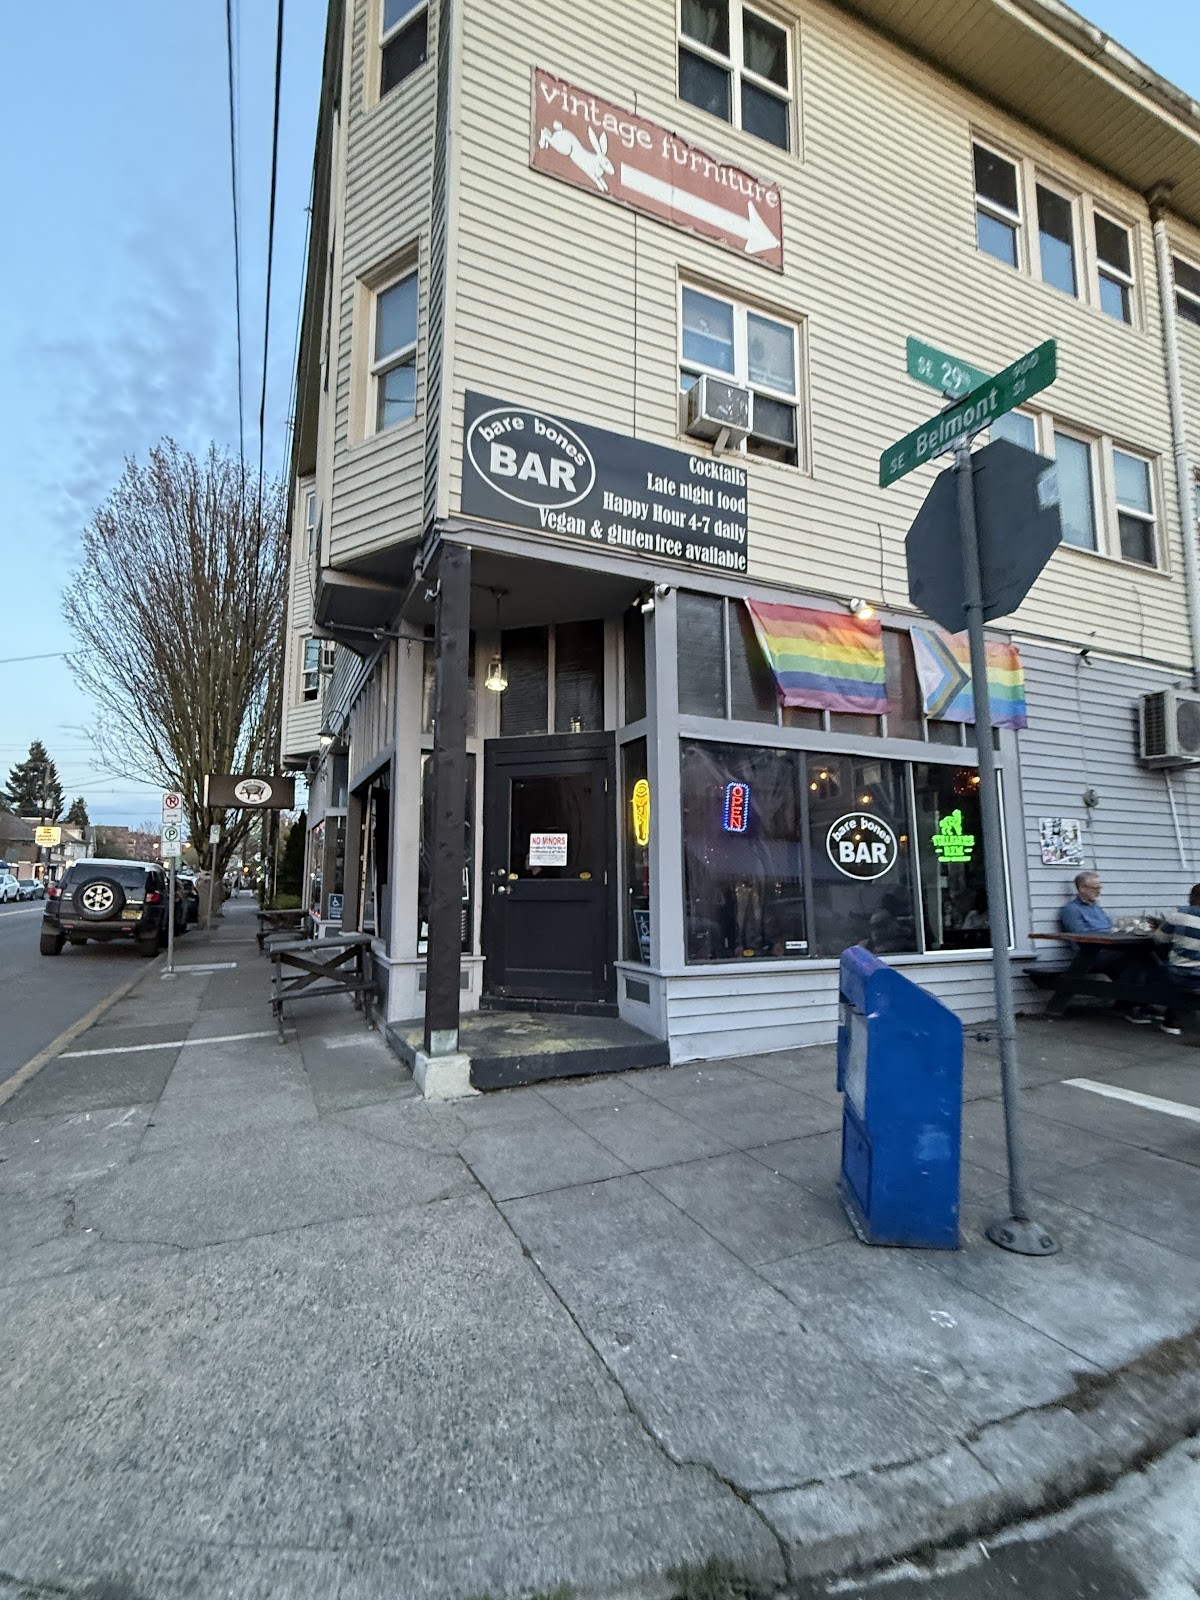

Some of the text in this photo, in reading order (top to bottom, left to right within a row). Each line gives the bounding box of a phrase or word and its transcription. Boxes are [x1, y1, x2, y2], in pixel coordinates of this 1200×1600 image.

[540, 82, 780, 208] vintage furniture
[478, 416, 586, 467] bare bones
[889, 452, 905, 475] SE
[915, 387, 998, 458] Belmont
[490, 442, 577, 493] BAR
[689, 456, 746, 487] Cocktails
[603, 490, 746, 544] Happy Hour 4-7 daily
[647, 472, 746, 515] Late night food
[539, 507, 746, 571] Vegan & gluten free available
[730, 786, 743, 829] OPEN
[831, 817, 892, 845] bare bones
[531, 836, 566, 846] NO MINORS
[839, 841, 889, 864] BAR
